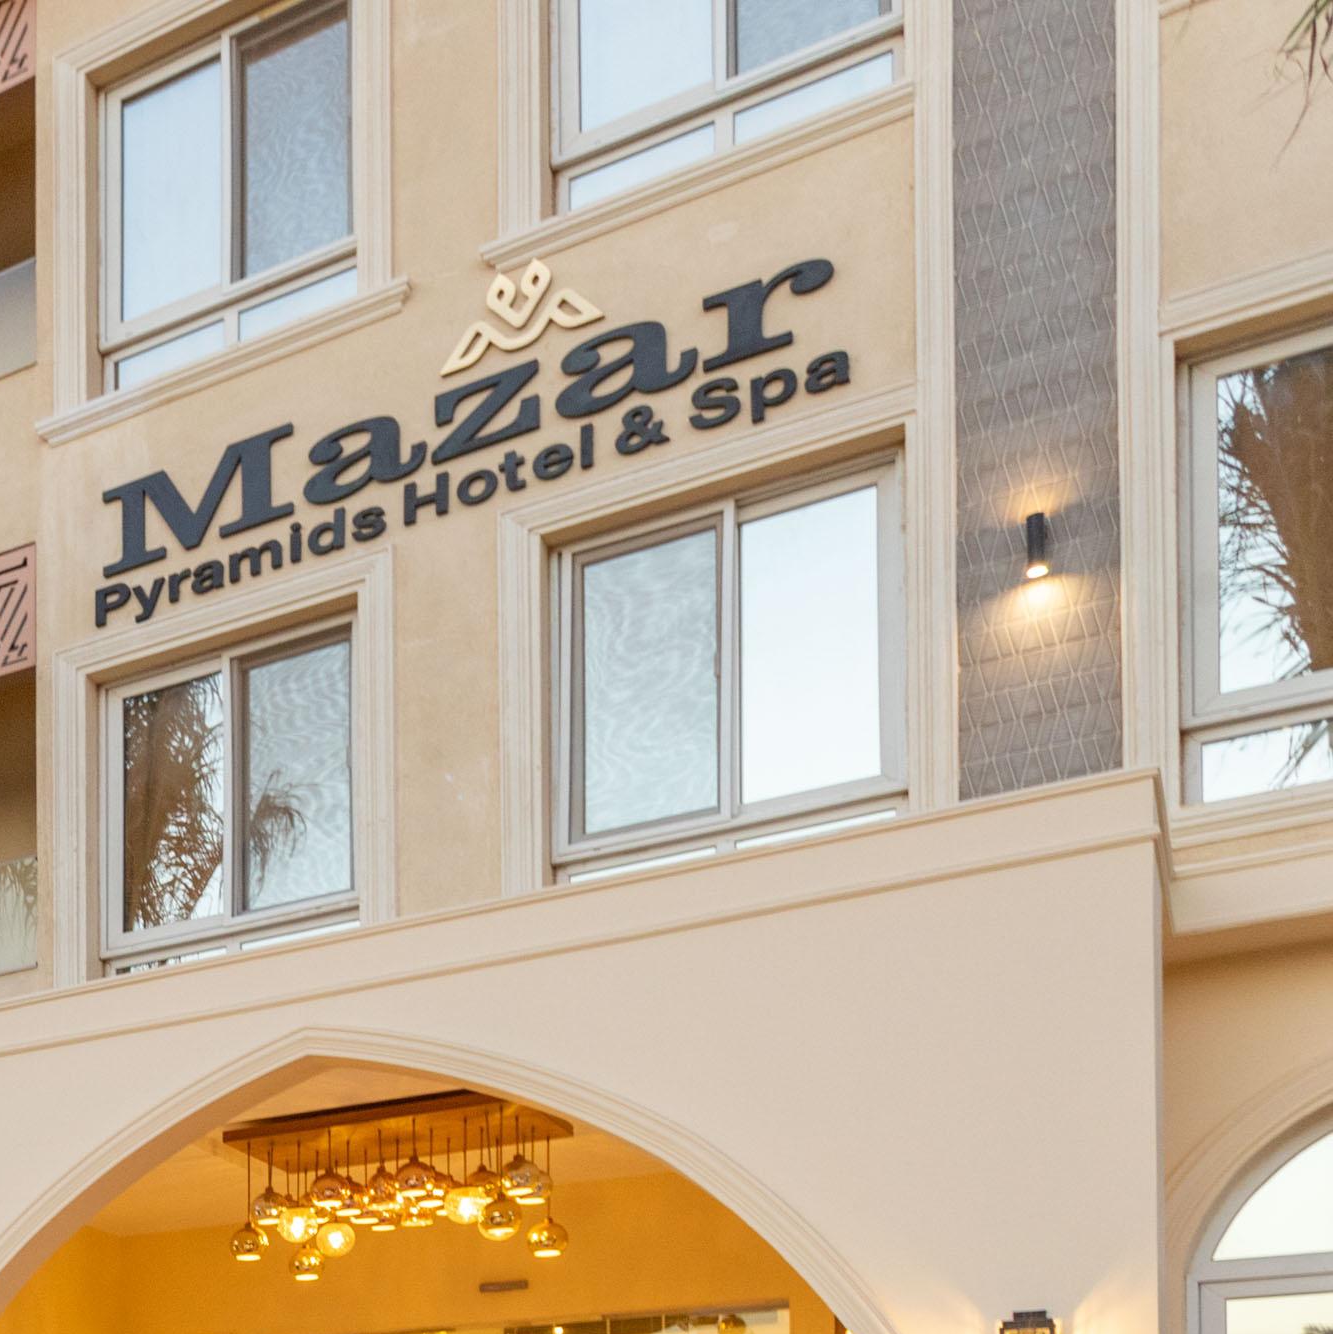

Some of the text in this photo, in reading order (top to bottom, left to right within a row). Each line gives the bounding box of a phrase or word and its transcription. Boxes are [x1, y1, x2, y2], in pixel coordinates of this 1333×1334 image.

[94, 349, 852, 629] Pyramids Hotel & Spa
[101, 257, 836, 580] Mazar
